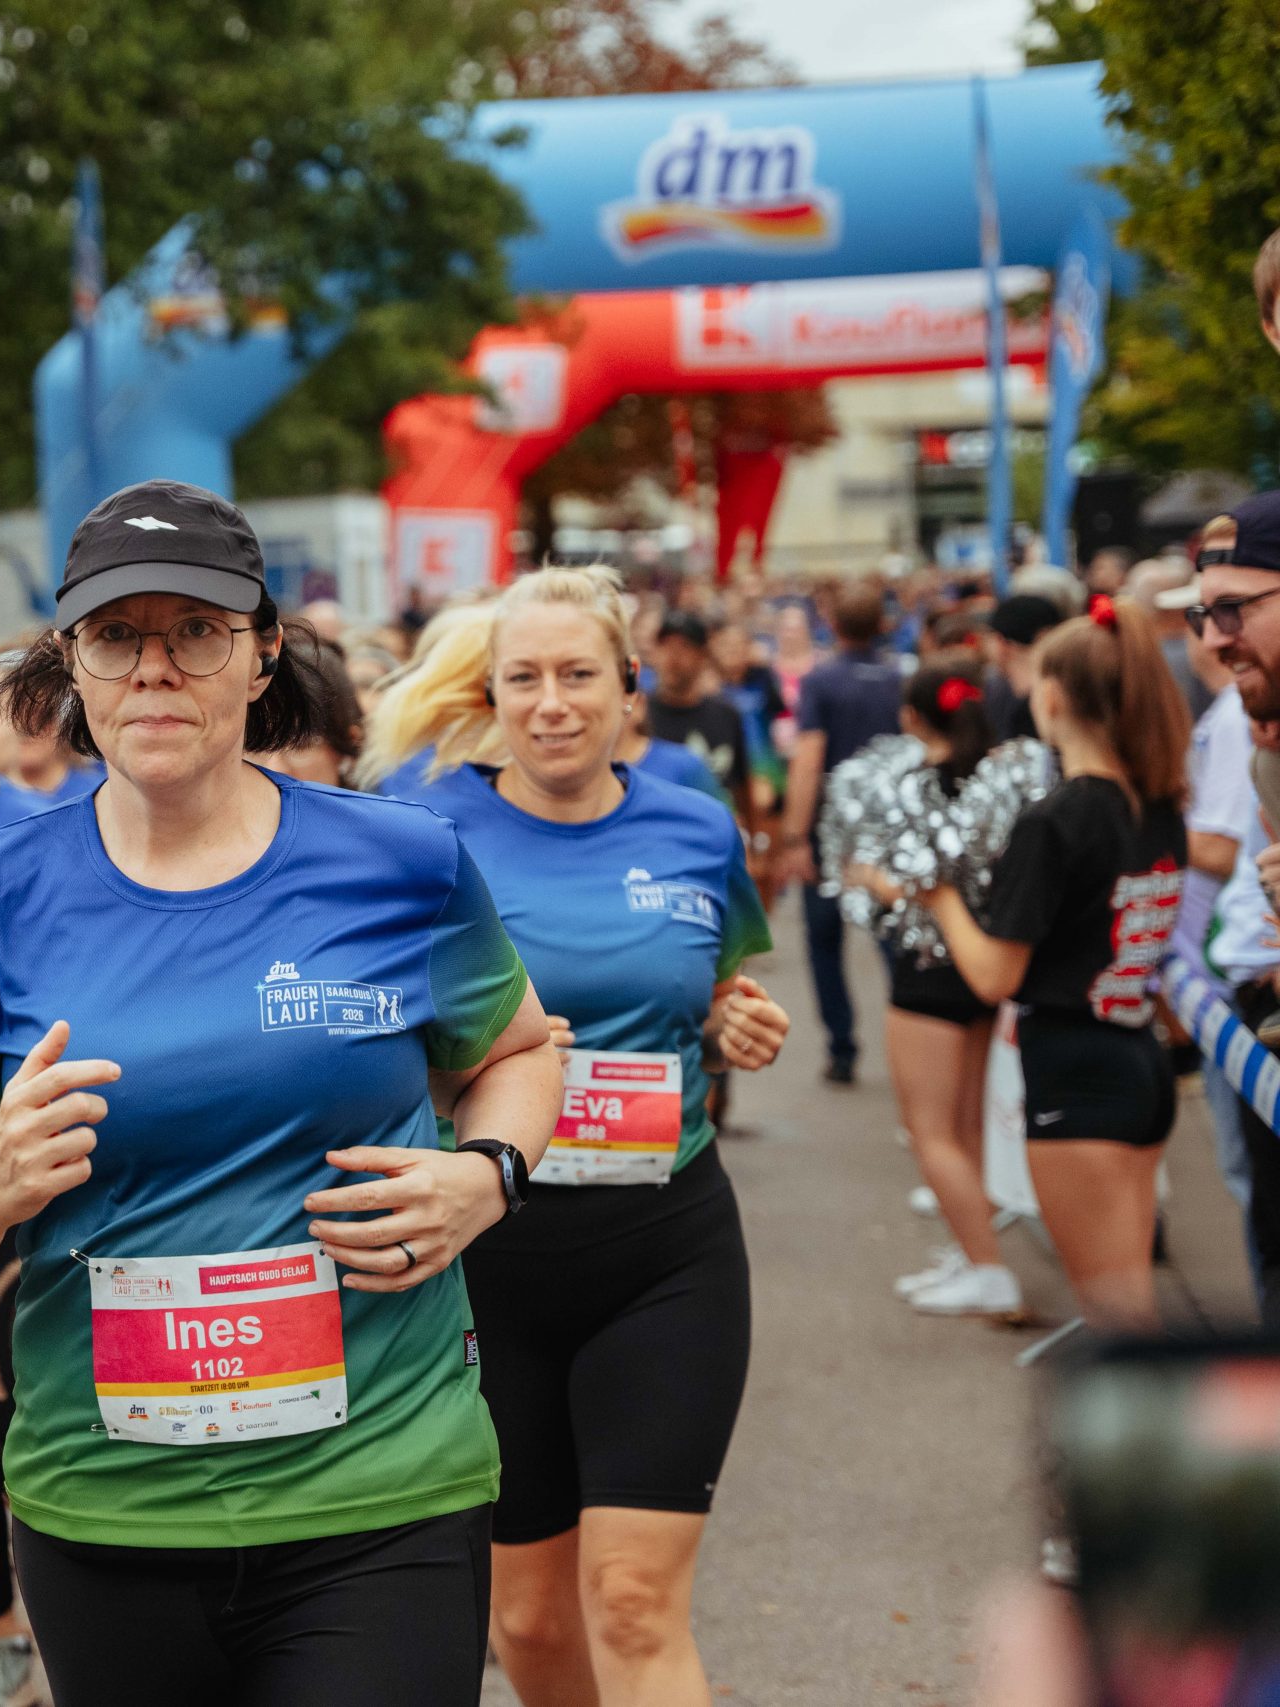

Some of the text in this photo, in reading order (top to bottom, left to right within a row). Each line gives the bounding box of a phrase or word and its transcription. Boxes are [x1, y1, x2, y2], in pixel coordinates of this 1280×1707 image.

[655, 129, 797, 197] dm
[793, 307, 995, 343] Kauflan
[270, 960, 297, 975] dm
[267, 986, 319, 1004] FRAUEN
[326, 987, 372, 1000] SAARLOUIS
[267, 1001, 319, 1025] LAUF
[342, 1008, 364, 1022] 2026
[562, 1088, 623, 1121] Eva
[209, 1271, 257, 1287] HAUPTSACH
[282, 1264, 310, 1278] GELAAF
[114, 1286, 132, 1295] LAUF
[165, 1311, 263, 1350] Ines
[191, 1356, 245, 1380] 1102
[190, 1383, 220, 1393] STARTZEIT
[237, 1380, 250, 1389] UHR
[130, 1403, 146, 1414] dm
[243, 1402, 272, 1411] Kaufland
